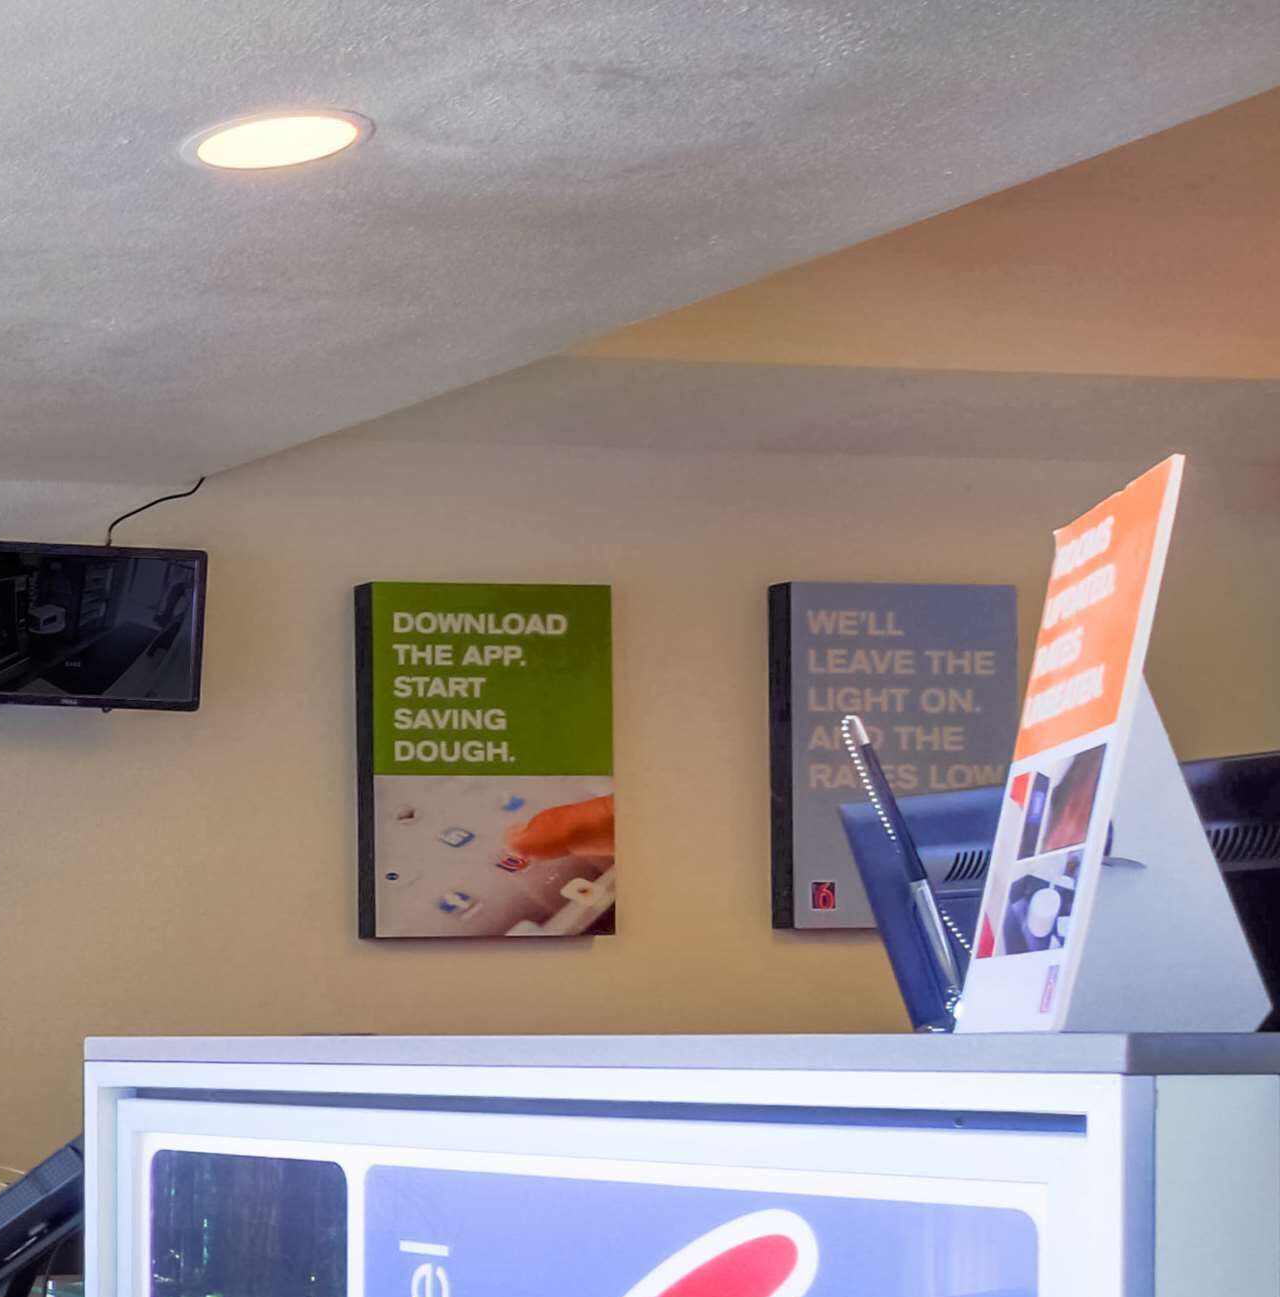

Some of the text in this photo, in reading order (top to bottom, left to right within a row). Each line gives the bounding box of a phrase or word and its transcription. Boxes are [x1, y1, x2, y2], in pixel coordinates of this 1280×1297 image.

[392, 612, 568, 636] DOWNLOAD
[807, 610, 904, 636] WE'LL
[393, 643, 526, 667] THE APP.
[807, 649, 995, 675] LEAVE THE
[394, 676, 486, 698] START
[807, 687, 982, 714] LIGHT ON.
[394, 708, 507, 731] SAVING
[894, 725, 964, 751] THE
[394, 740, 515, 763] DOUGH.
[809, 763, 1005, 789] RAES LOW
